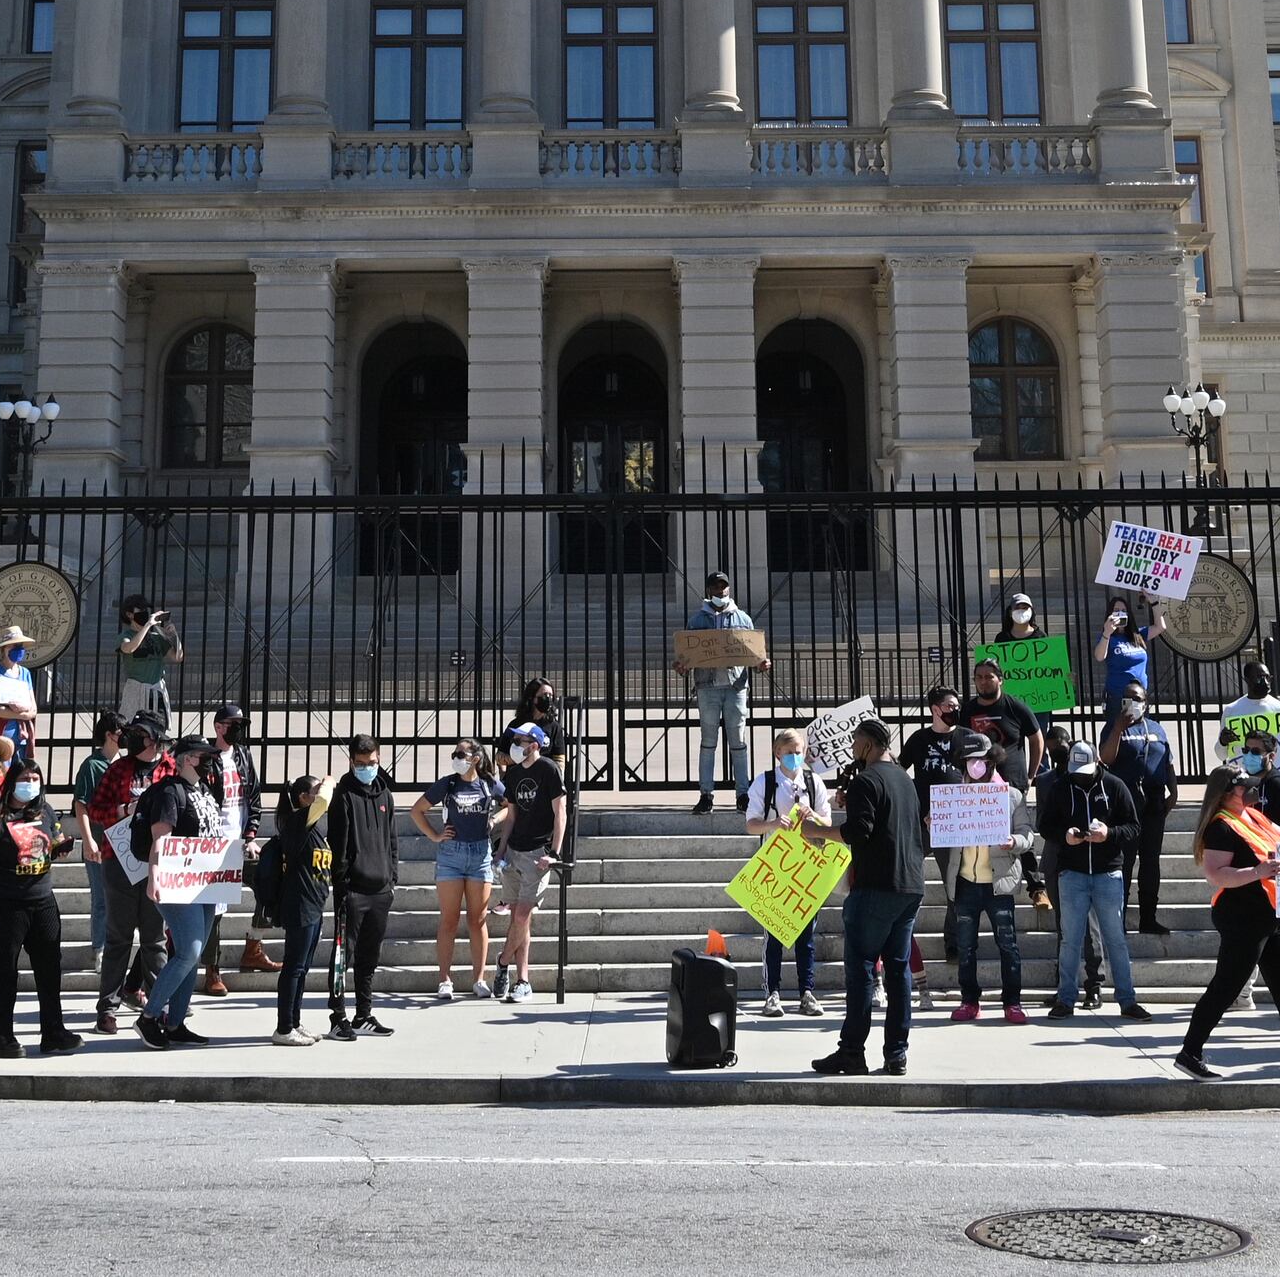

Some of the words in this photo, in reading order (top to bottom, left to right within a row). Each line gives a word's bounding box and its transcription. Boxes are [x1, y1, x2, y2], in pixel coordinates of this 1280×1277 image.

[1114, 525, 1157, 545] TEACH
[1157, 533, 1191, 554] REAL
[1119, 540, 1179, 565] HISTORY
[1114, 554, 1151, 573] DONT
[1151, 562, 1182, 581] BAN
[1115, 569, 1160, 591] BOOKS
[1202, 563, 1246, 615] GEORGIA
[9, 572, 23, 582] OF
[30, 572, 69, 624] GEORGIA
[26, 652, 37, 660] 76
[985, 641, 1048, 662] STOP
[1195, 643, 1219, 652] 1776
[1003, 667, 1063, 680] assroom
[807, 714, 837, 736] OUR
[808, 707, 877, 745] CHILDREN
[1229, 715, 1270, 737] END
[517, 791, 537, 800] NASA
[931, 787, 954, 795] THEY
[956, 786, 976, 795] TOOK
[457, 804, 483, 814] WORLD
[931, 800, 953, 809] THEY
[955, 799, 976, 807] TOOK
[980, 797, 998, 805] MLK
[957, 811, 972, 819] LET
[977, 808, 1003, 817] THEM
[933, 824, 955, 833] TAKE
[978, 821, 1008, 829] HISTORY
[162, 837, 229, 856] HISTORY
[802, 842, 827, 869] THE
[766, 834, 820, 900] FULL
[159, 869, 242, 890] UNCOMFORTABLE
[751, 856, 813, 920] TRUTH
[738, 873, 800, 934] #StopClassroom
[750, 903, 790, 942] Censorship
